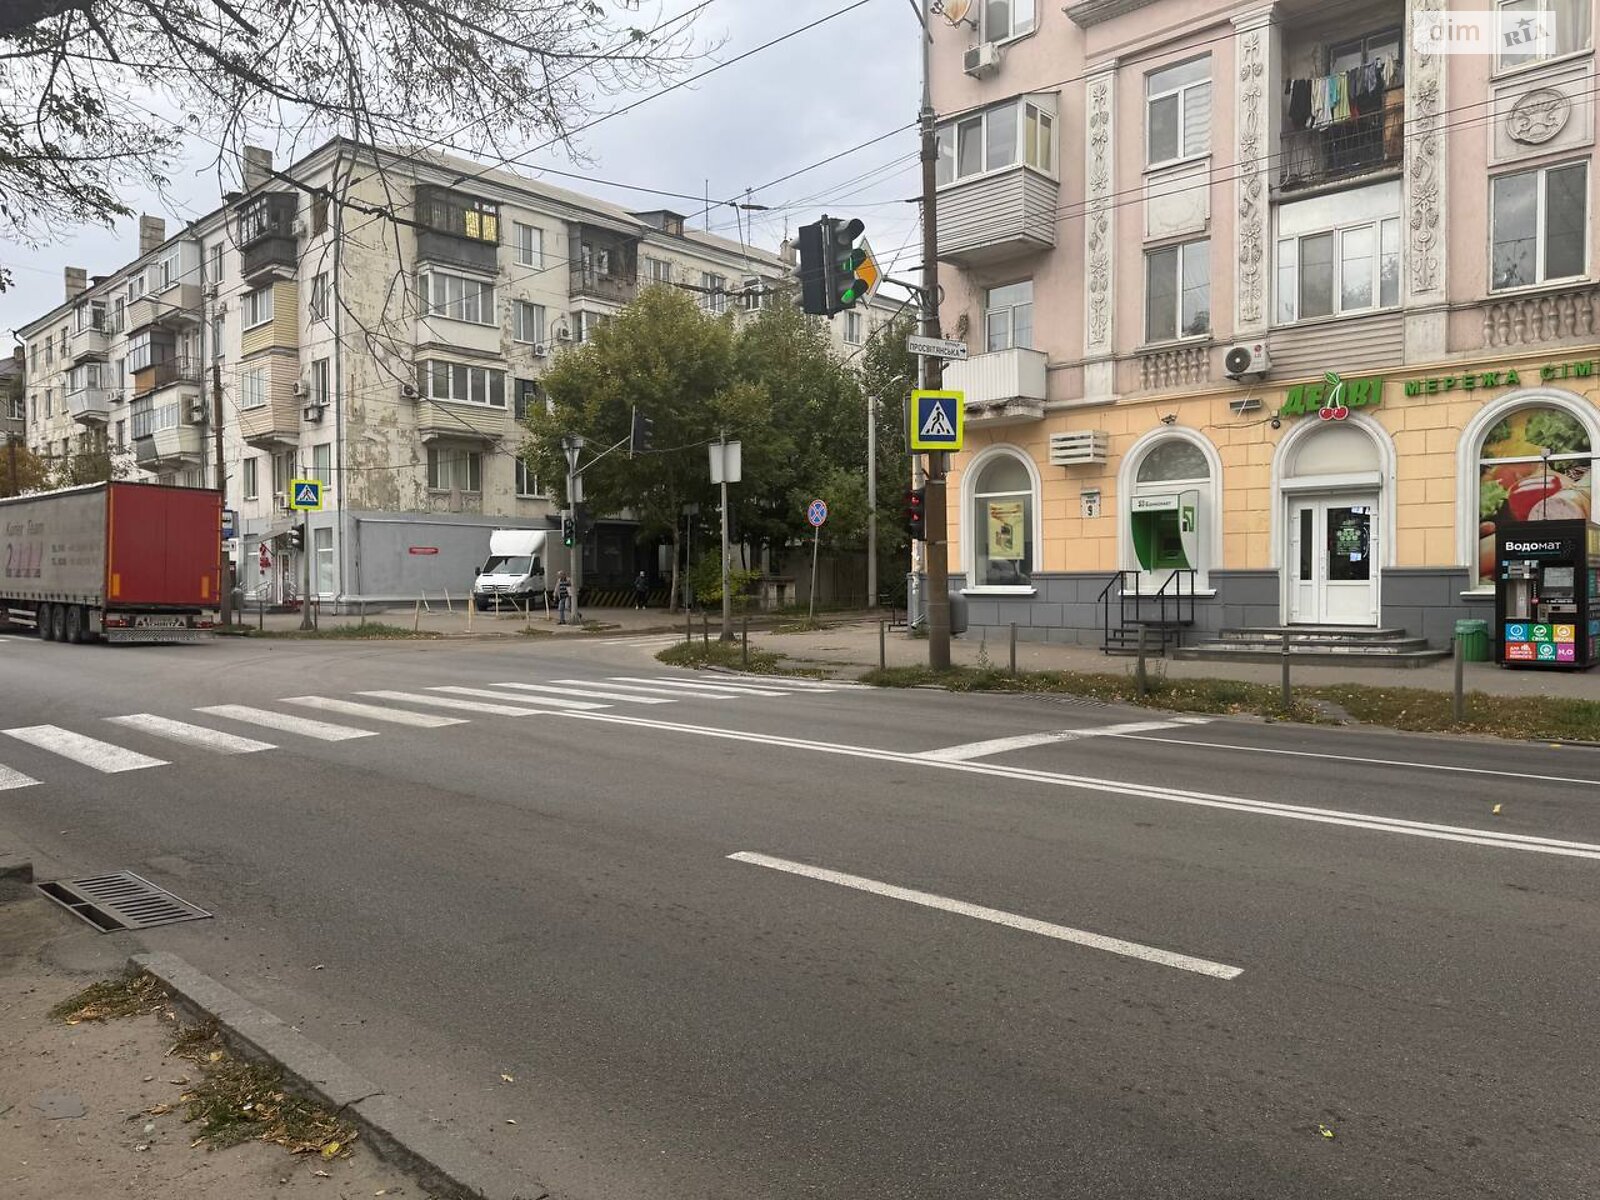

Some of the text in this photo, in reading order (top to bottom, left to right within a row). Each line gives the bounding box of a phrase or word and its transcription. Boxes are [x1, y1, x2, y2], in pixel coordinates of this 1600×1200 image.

[1404, 368, 1521, 398] МЕРЕЖА
[1087, 504, 1093, 516] 9
[1505, 541, 1562, 552] Водомат
